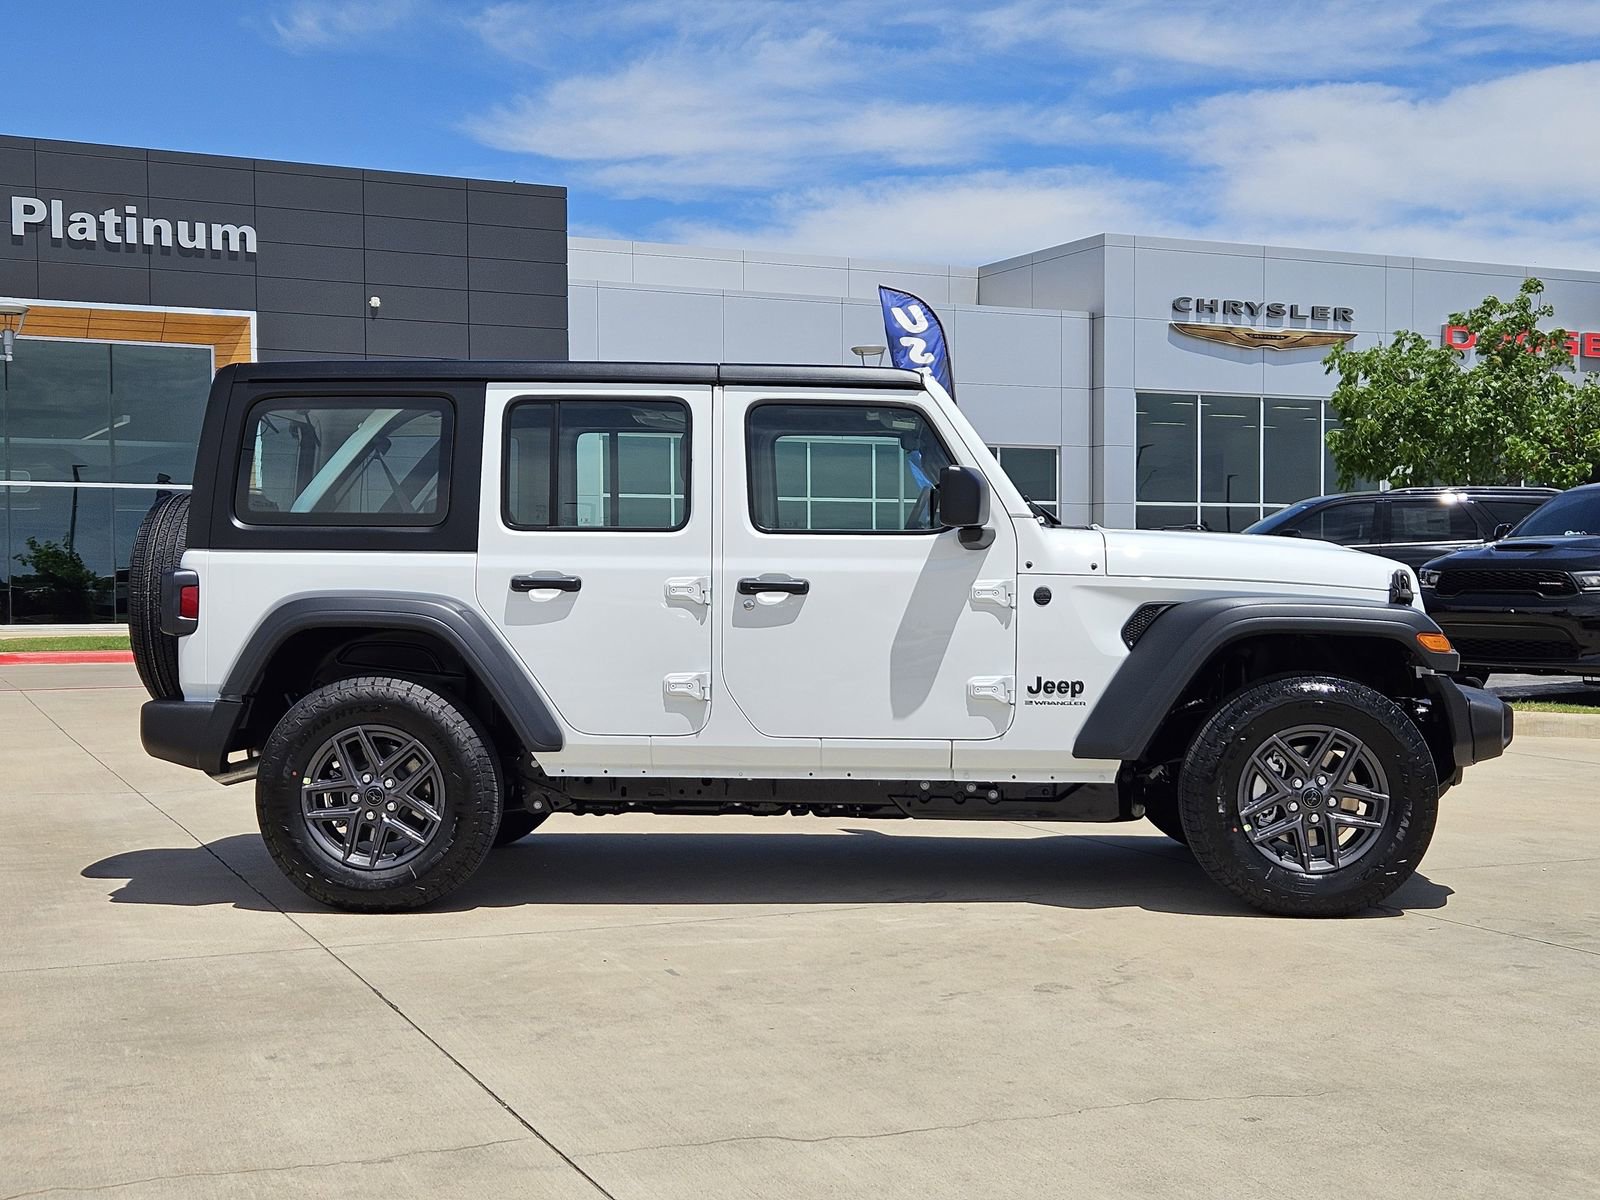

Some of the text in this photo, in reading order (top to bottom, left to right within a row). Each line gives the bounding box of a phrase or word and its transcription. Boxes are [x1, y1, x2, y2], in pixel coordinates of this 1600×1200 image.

[11, 196, 257, 252] Platinum
[1172, 296, 1355, 322] CHRYSLER
[1027, 676, 1084, 698] Jeep
